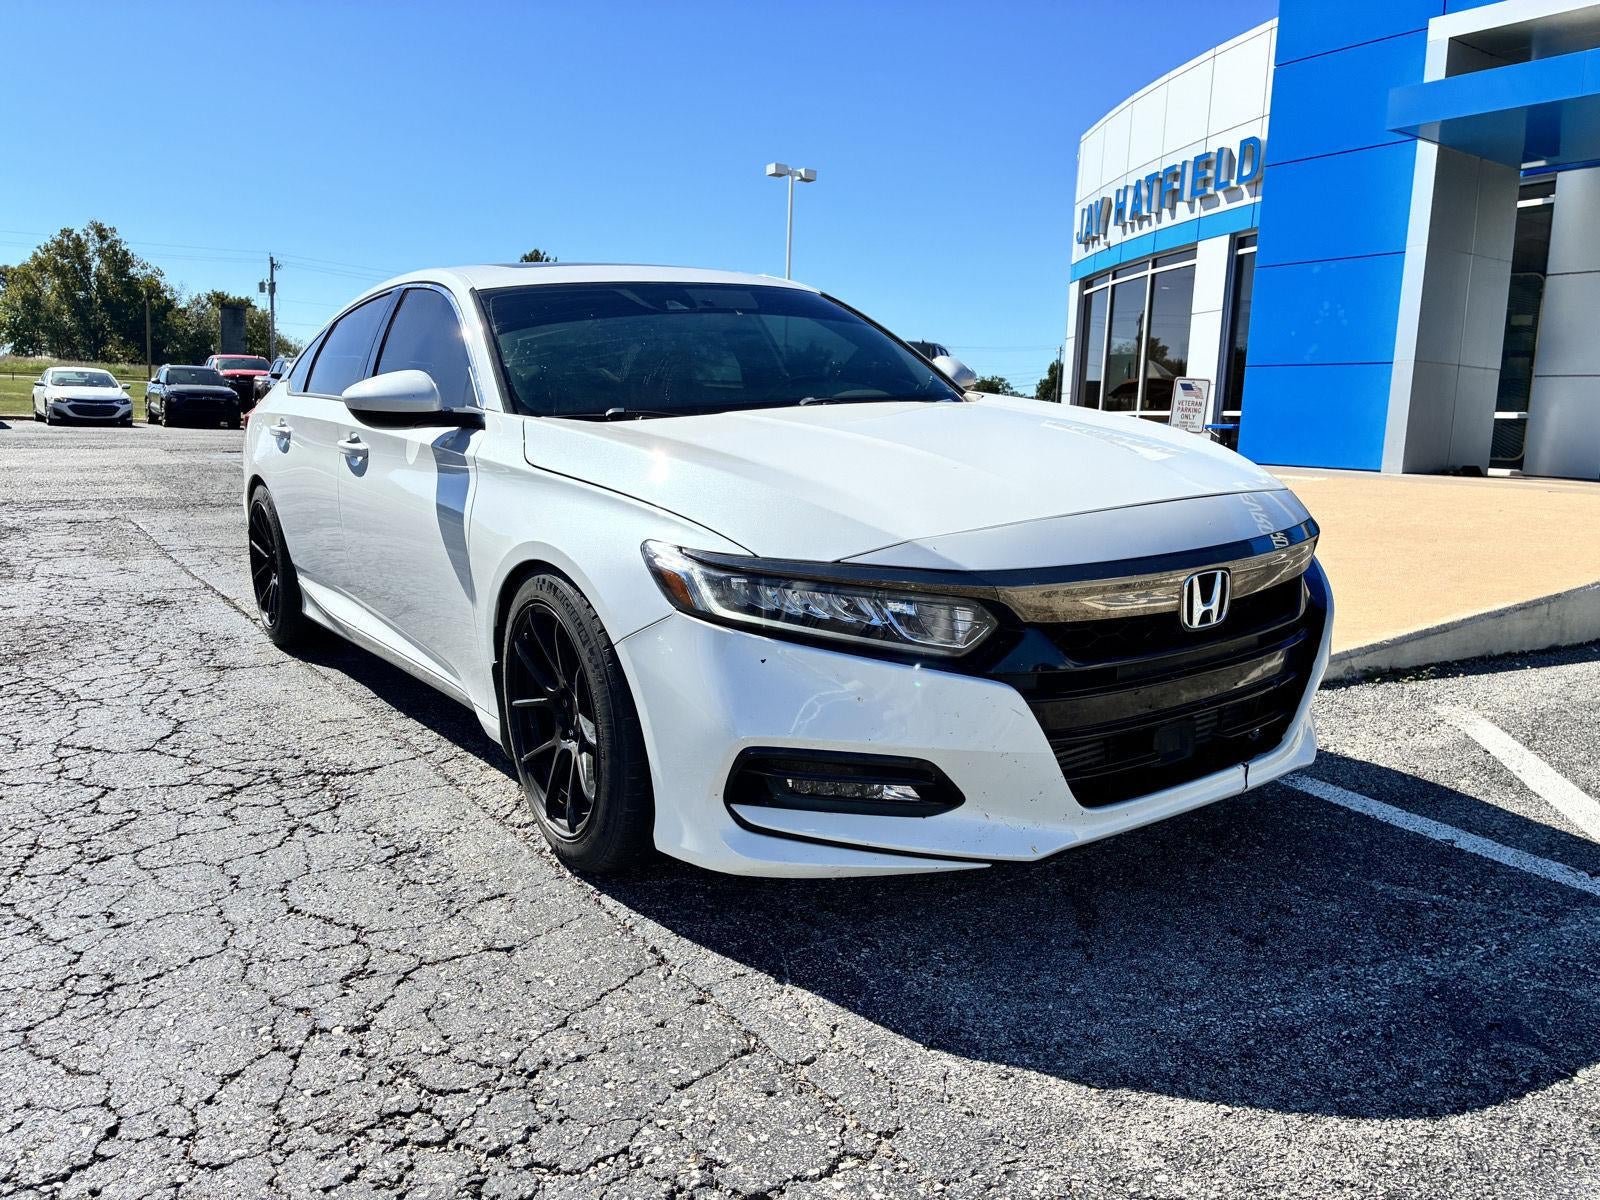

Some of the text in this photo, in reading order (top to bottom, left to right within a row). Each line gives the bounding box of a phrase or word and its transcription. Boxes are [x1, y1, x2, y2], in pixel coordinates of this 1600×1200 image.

[1076, 136, 1263, 245] JAY HATFIELD
[1176, 406, 1201, 414] PARKING
[555, 587, 591, 649] MICHELIN
